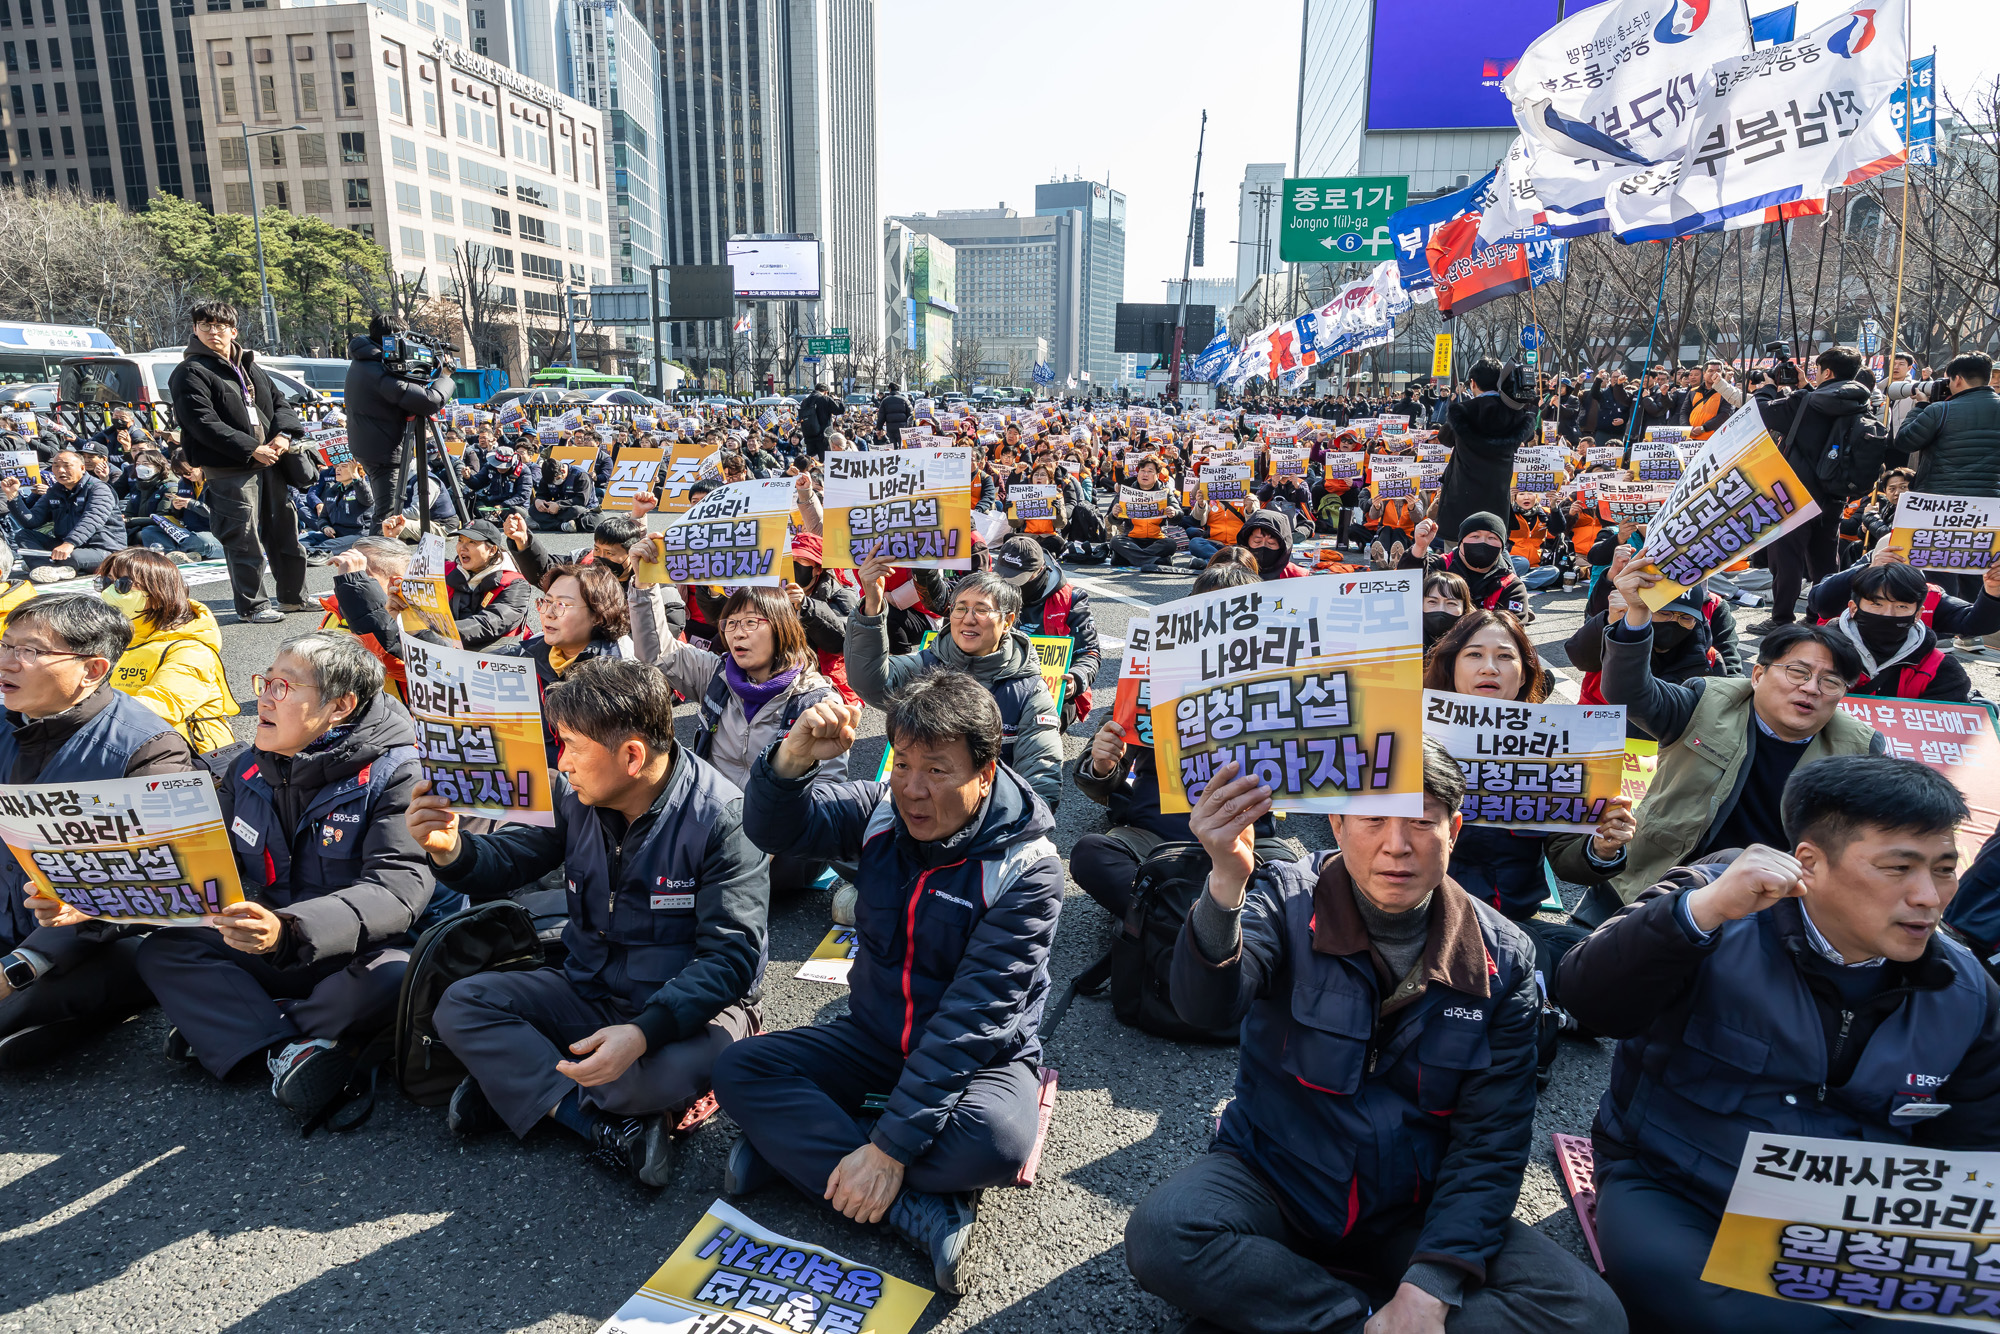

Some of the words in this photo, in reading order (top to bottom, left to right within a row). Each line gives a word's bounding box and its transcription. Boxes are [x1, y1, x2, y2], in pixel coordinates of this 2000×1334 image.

[459, 49, 495, 79] SEOUL
[494, 65, 537, 97] FINANCE
[1292, 185, 1395, 211] 종로1가
[1290, 215, 1329, 232] Jongno
[1333, 214, 1369, 231] 1(il)-ga
[1345, 236, 1355, 249] 6
[1513, 455, 1541, 464] 진짜사장
[1648, 451, 1675, 459] 나와라!
[829, 455, 901, 480] 진짜사장
[1526, 463, 1551, 471] 나와라!
[1639, 459, 1680, 470] 원청교섭
[608, 460, 661, 498] 쟁
[1214, 472, 1237, 481] 나와라!
[1384, 470, 1408, 479] 나와라!
[1517, 473, 1554, 483] 원청교섭
[869, 470, 925, 501] 나와라!
[1207, 481, 1241, 491] 원청교섭
[1378, 479, 1411, 489] 원청교섭
[1599, 482, 1617, 492] 모든
[1617, 484, 1654, 494] 노동자의
[1021, 491, 1043, 499] 나와라!
[1601, 493, 1643, 502] 노동기본권
[688, 496, 751, 521] 나와라!
[1015, 499, 1047, 511] 원청교섭
[1608, 501, 1661, 514] 투쟁으로
[1905, 496, 1968, 513] 진짜사장
[849, 498, 939, 536] 원청교섭
[1645, 467, 1755, 565] 원청교섭
[1933, 514, 1989, 529] 나와라!
[664, 520, 758, 551] 원청교섭
[1660, 480, 1796, 586] 쟁취하자!
[1912, 529, 1995, 550] 원청교섭
[665, 549, 774, 582] 쟁취하자!
[1358, 579, 1411, 594] 민주노총
[1154, 591, 1263, 651] 진짜사장
[1200, 617, 1322, 682] 나와라!
[117, 665, 149, 682] 정의당
[490, 661, 527, 675] 민주노총
[1175, 671, 1351, 750] 원청교섭
[1426, 697, 1532, 731] 진짜사장
[1594, 710, 1621, 719] 민주노총
[1875, 705, 1898, 728] 후
[1900, 707, 1986, 736] 집단해고
[219, 744, 244, 757] 민주노총
[1476, 730, 1569, 758] 나와라!
[161, 777, 204, 790] 민주노총
[0, 789, 84, 819] 짜사장
[332, 812, 361, 823] 민주노총
[36, 808, 146, 846] 나와라!
[32, 844, 184, 884] 원청교섭
[53, 878, 223, 918] 쟁취하자!
[1752, 1143, 1951, 1192] 진짜사장
[696, 1226, 884, 1309] 쟁취하자!
